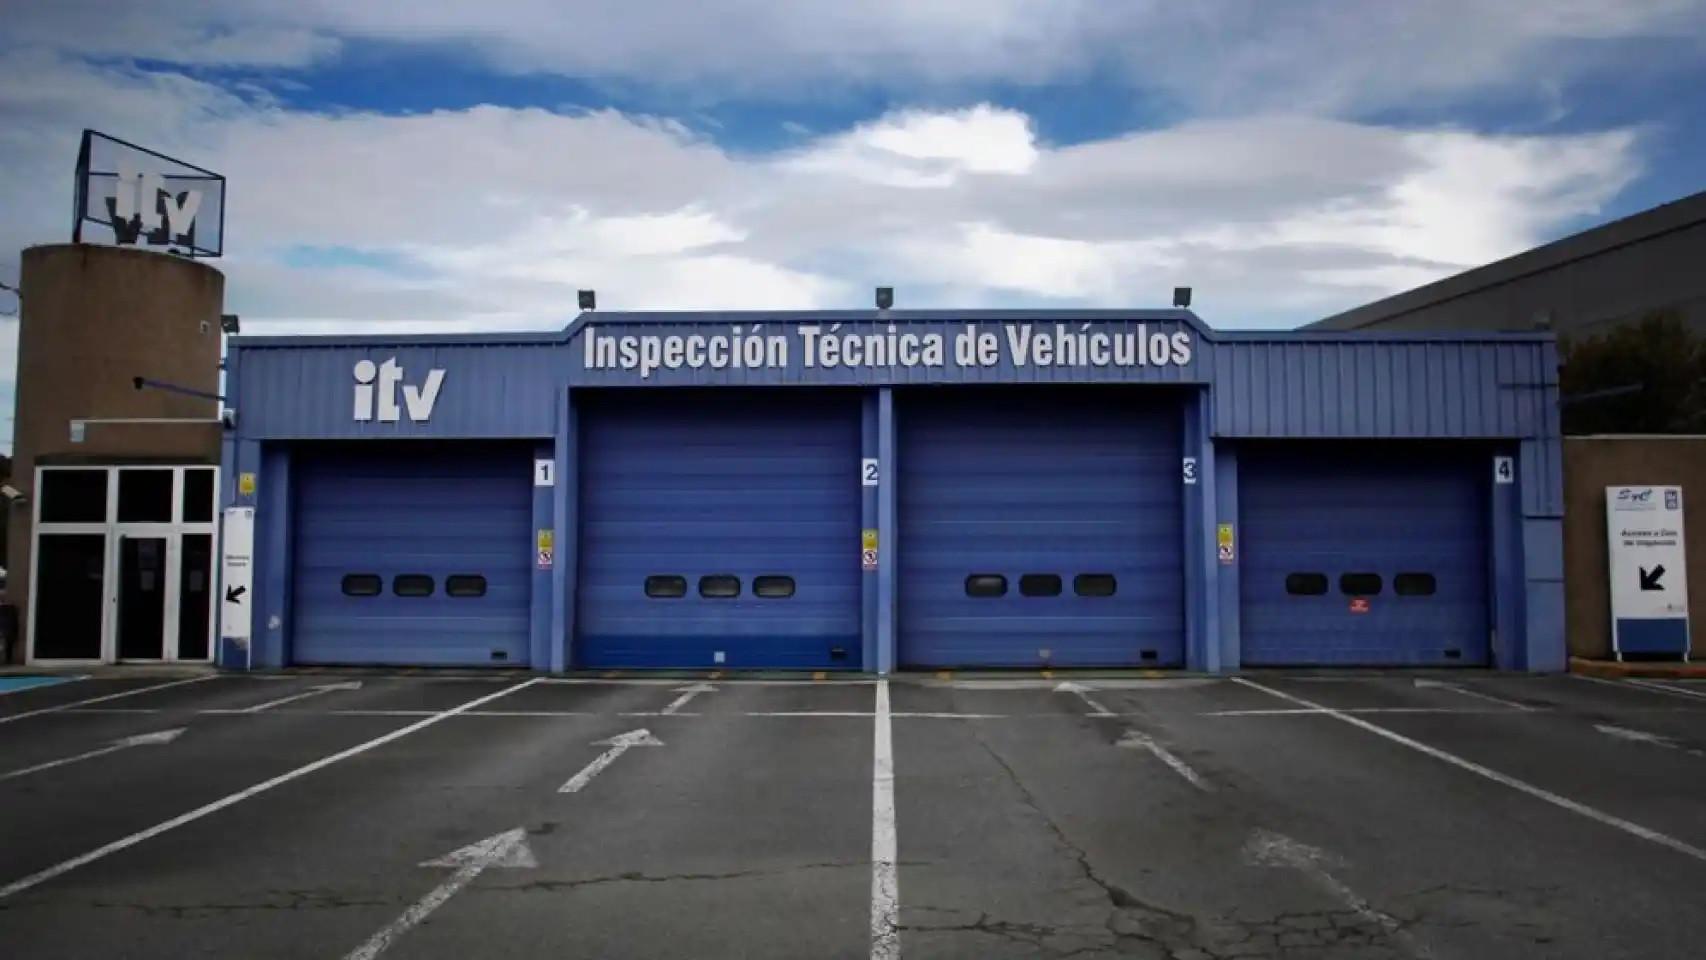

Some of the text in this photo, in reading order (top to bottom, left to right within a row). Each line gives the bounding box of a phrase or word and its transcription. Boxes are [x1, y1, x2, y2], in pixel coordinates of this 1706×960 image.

[583, 322, 1192, 378] Inspección Técnica de Vehículos
[353, 356, 447, 421] itv
[540, 463, 549, 481] 1
[866, 462, 878, 481] 2
[1184, 462, 1197, 479] 3
[1499, 460, 1510, 480] 4
